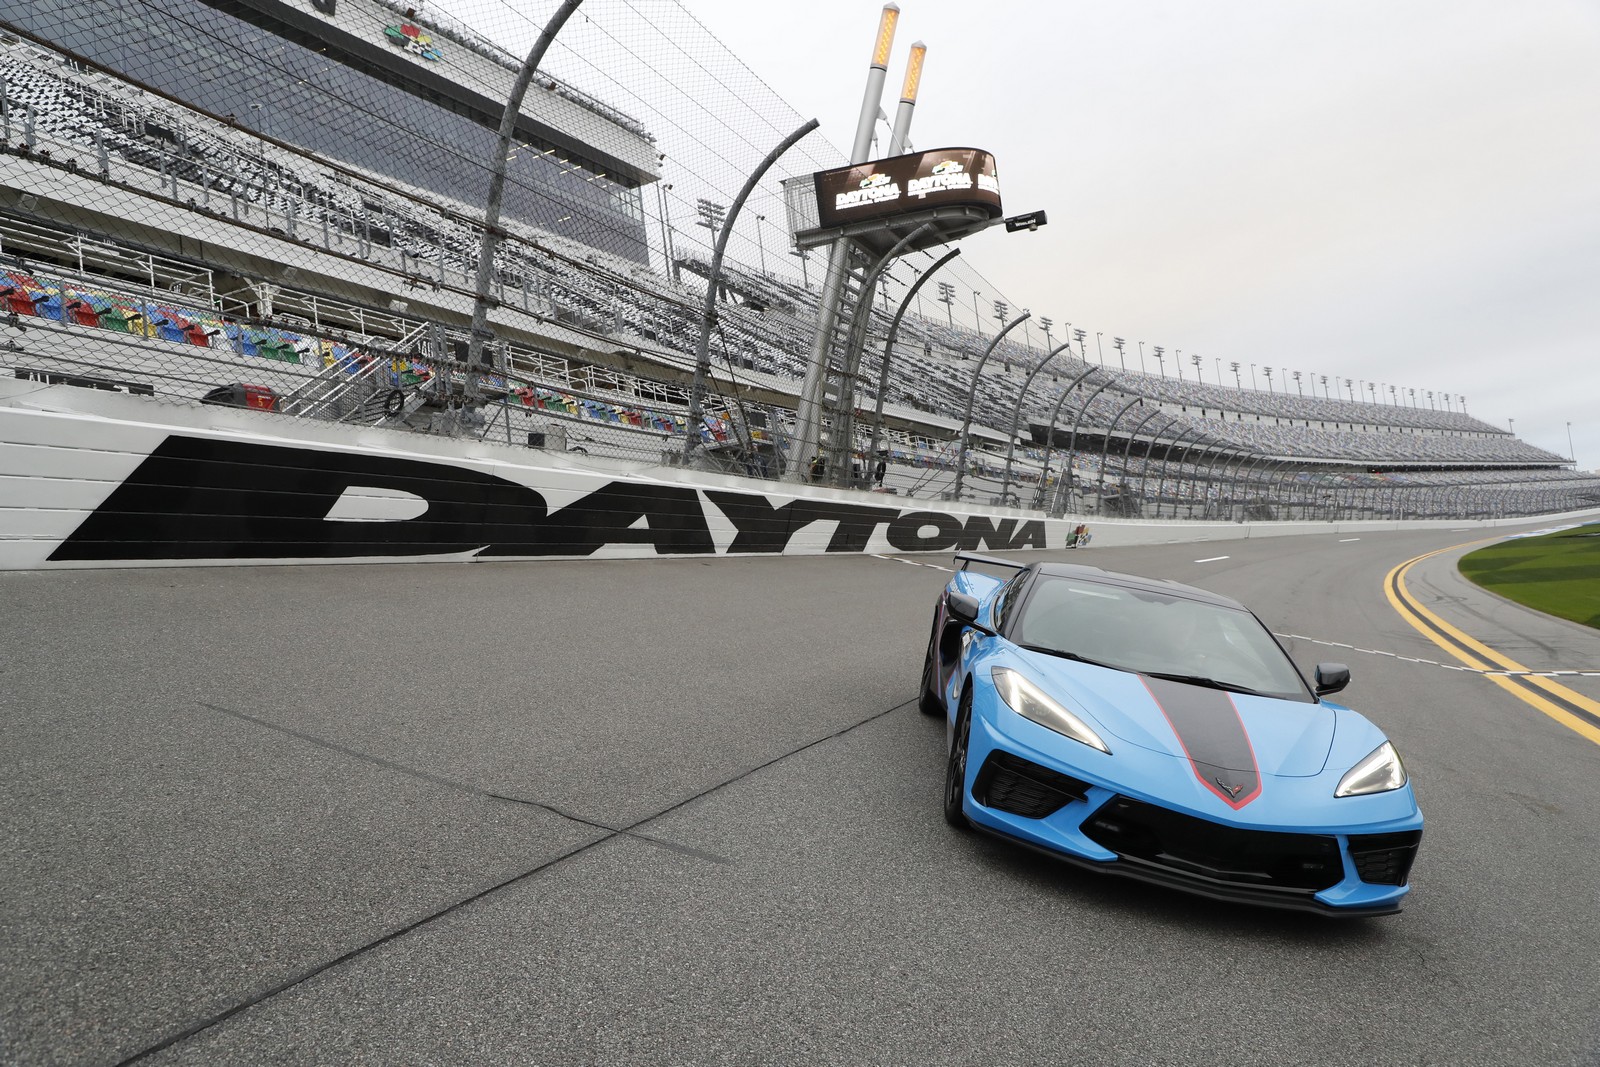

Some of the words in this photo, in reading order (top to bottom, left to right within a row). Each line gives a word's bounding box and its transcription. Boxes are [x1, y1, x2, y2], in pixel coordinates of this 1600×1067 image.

[908, 173, 972, 192] DAYTONA
[836, 183, 900, 206] DAYTONA
[46, 435, 1047, 562] DAYTONA
